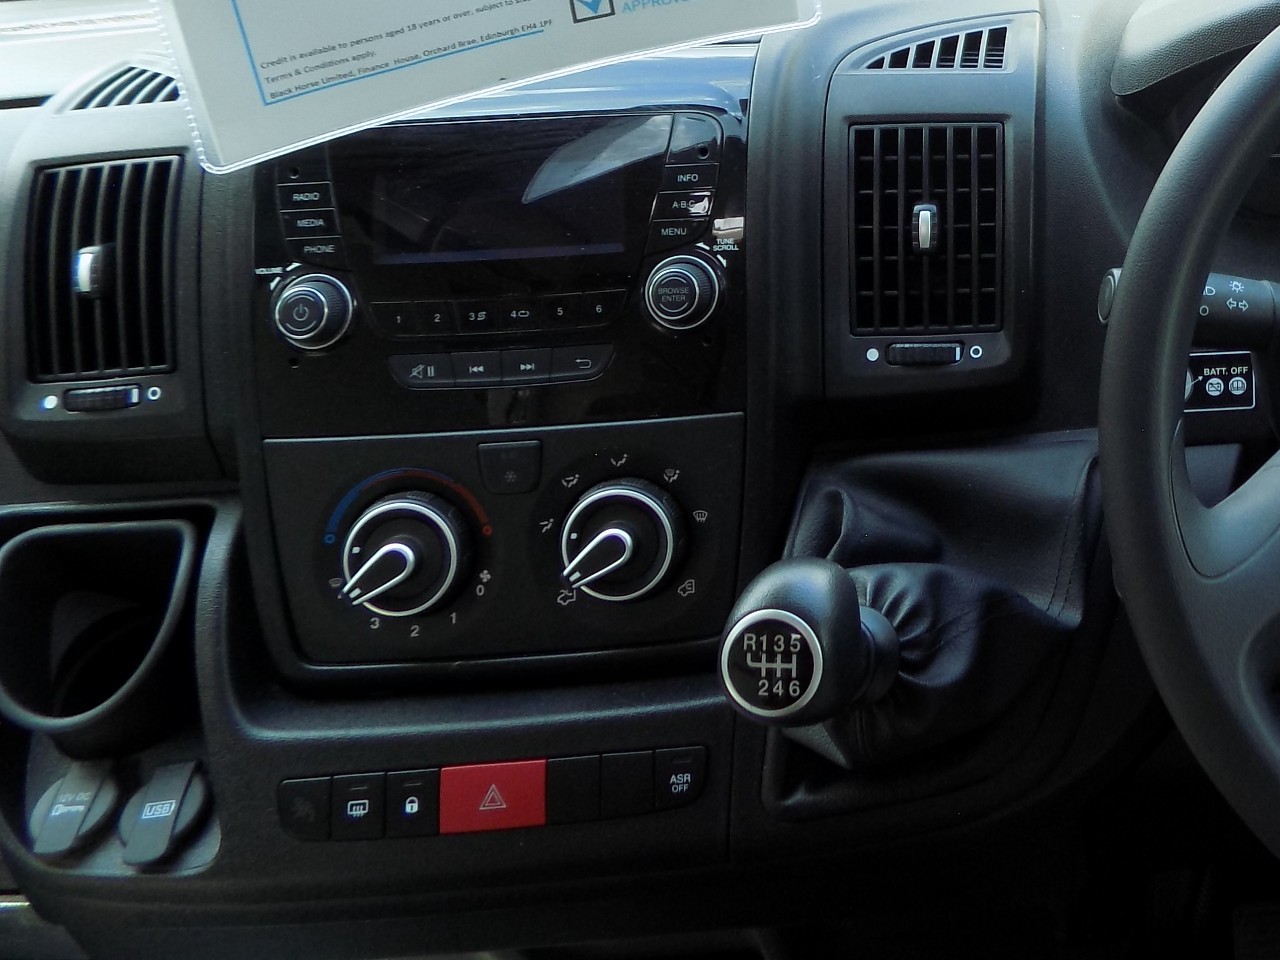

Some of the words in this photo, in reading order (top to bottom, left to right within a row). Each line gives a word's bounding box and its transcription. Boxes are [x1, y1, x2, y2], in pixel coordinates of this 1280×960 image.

[260, 55, 288, 69] Credit
[299, 44, 336, 60] available
[349, 31, 383, 48] persons
[385, 27, 405, 39] aged
[407, 23, 417, 33] 18
[418, 19, 441, 30] years
[442, 14, 451, 23] or
[453, 10, 474, 20] over,
[475, 1, 503, 14] subject
[264, 72, 293, 84] Terms
[294, 68, 302, 76] &
[304, 57, 350, 74] Conditions
[352, 50, 377, 62] apply.
[270, 87, 293, 99] Black
[295, 80, 320, 91] Horse
[357, 61, 390, 74] Finance
[423, 42, 456, 57] Orchard
[480, 26, 520, 42] Edinburgh
[677, 173, 698, 182] INFO
[293, 191, 320, 201] RADIO
[296, 218, 325, 227] MEDIA
[661, 227, 687, 236] MENU
[304, 244, 335, 254] PHONE
[713, 244, 739, 252] SCROLL
[658, 286, 689, 295] BROWSE
[661, 295, 686, 303] ENTER
[557, 307, 564, 316] 5
[596, 304, 603, 313] 6
[434, 313, 441, 322] 2
[468, 312, 476, 321] 3
[510, 310, 517, 318] 4
[1203, 367, 1228, 376] BATT.
[1231, 366, 1249, 375] OFF
[476, 584, 485, 596] 0
[370, 617, 380, 629] 3
[449, 612, 456, 624] 1
[410, 625, 420, 637] 2
[669, 773, 691, 785] ASR
[671, 783, 690, 793] OFF
[145, 802, 171, 816] USB
